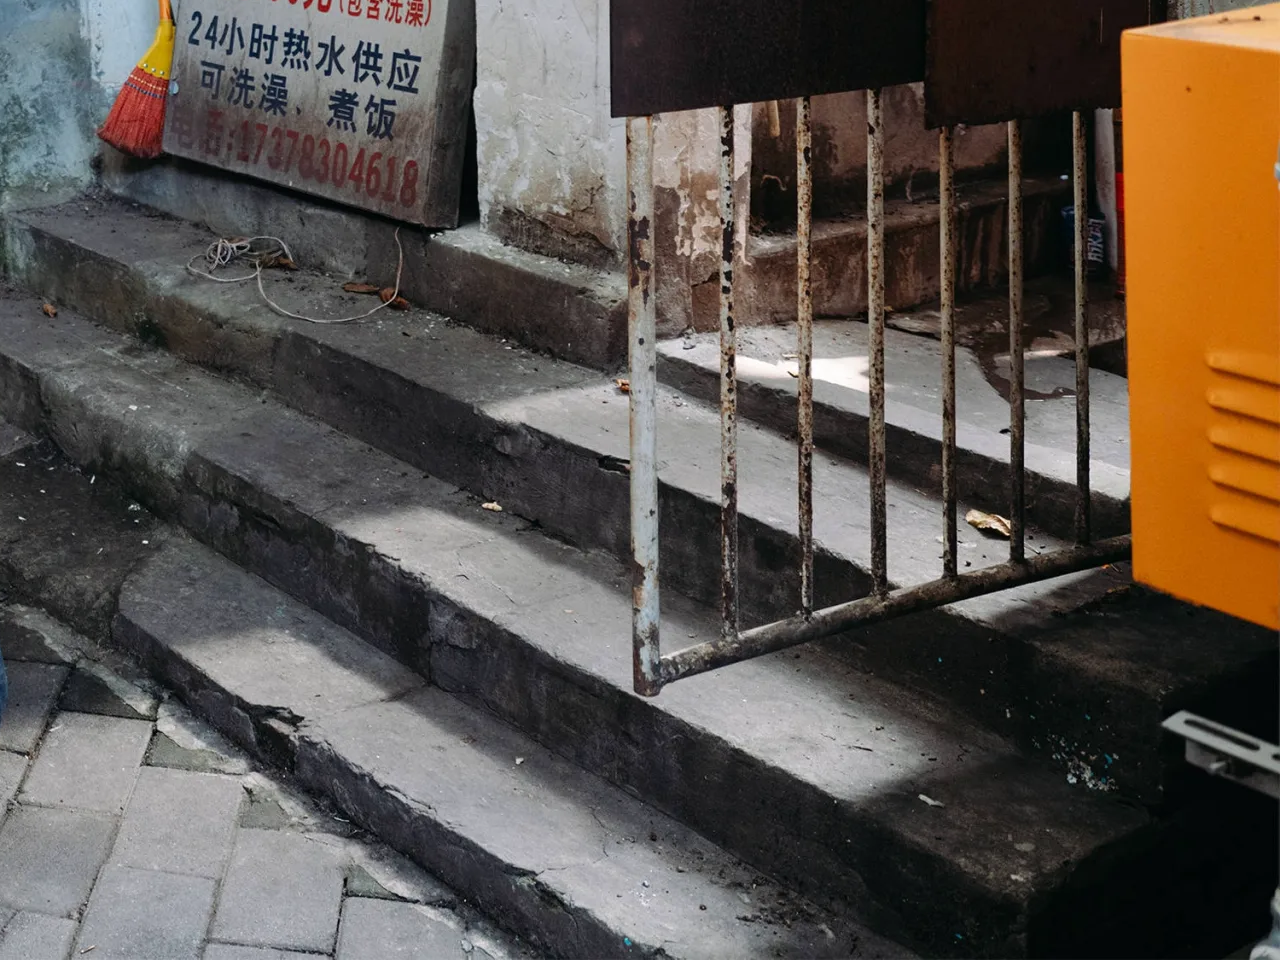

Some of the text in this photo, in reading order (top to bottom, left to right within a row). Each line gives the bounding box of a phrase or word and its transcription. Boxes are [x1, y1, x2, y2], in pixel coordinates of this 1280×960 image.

[188, 11, 422, 94] 24小时热水供应
